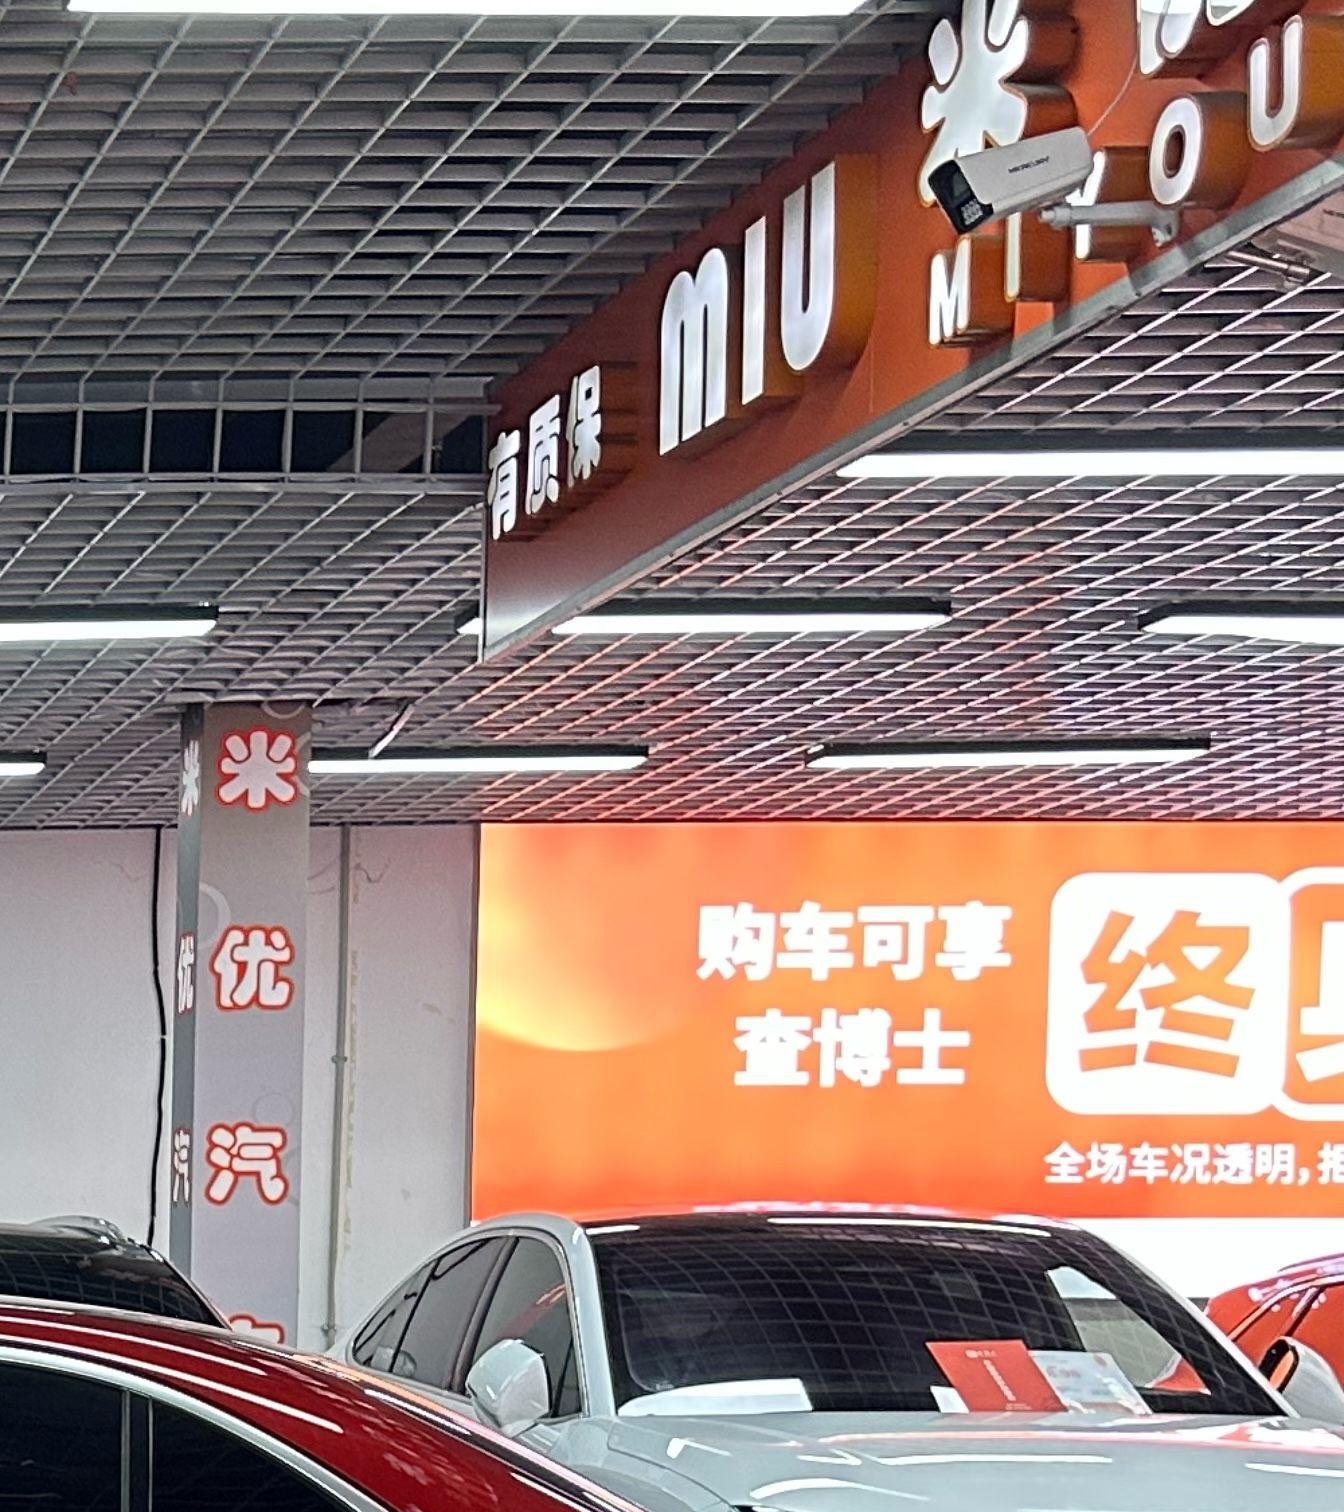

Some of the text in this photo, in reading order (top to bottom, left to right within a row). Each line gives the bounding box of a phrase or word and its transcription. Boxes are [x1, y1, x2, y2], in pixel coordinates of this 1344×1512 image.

[659, 161, 836, 457] MIU
[487, 364, 602, 541] 有质保
[696, 900, 1012, 981] 购车可享
[1078, 908, 1344, 1084] 终
[733, 1007, 971, 1088] 查博士
